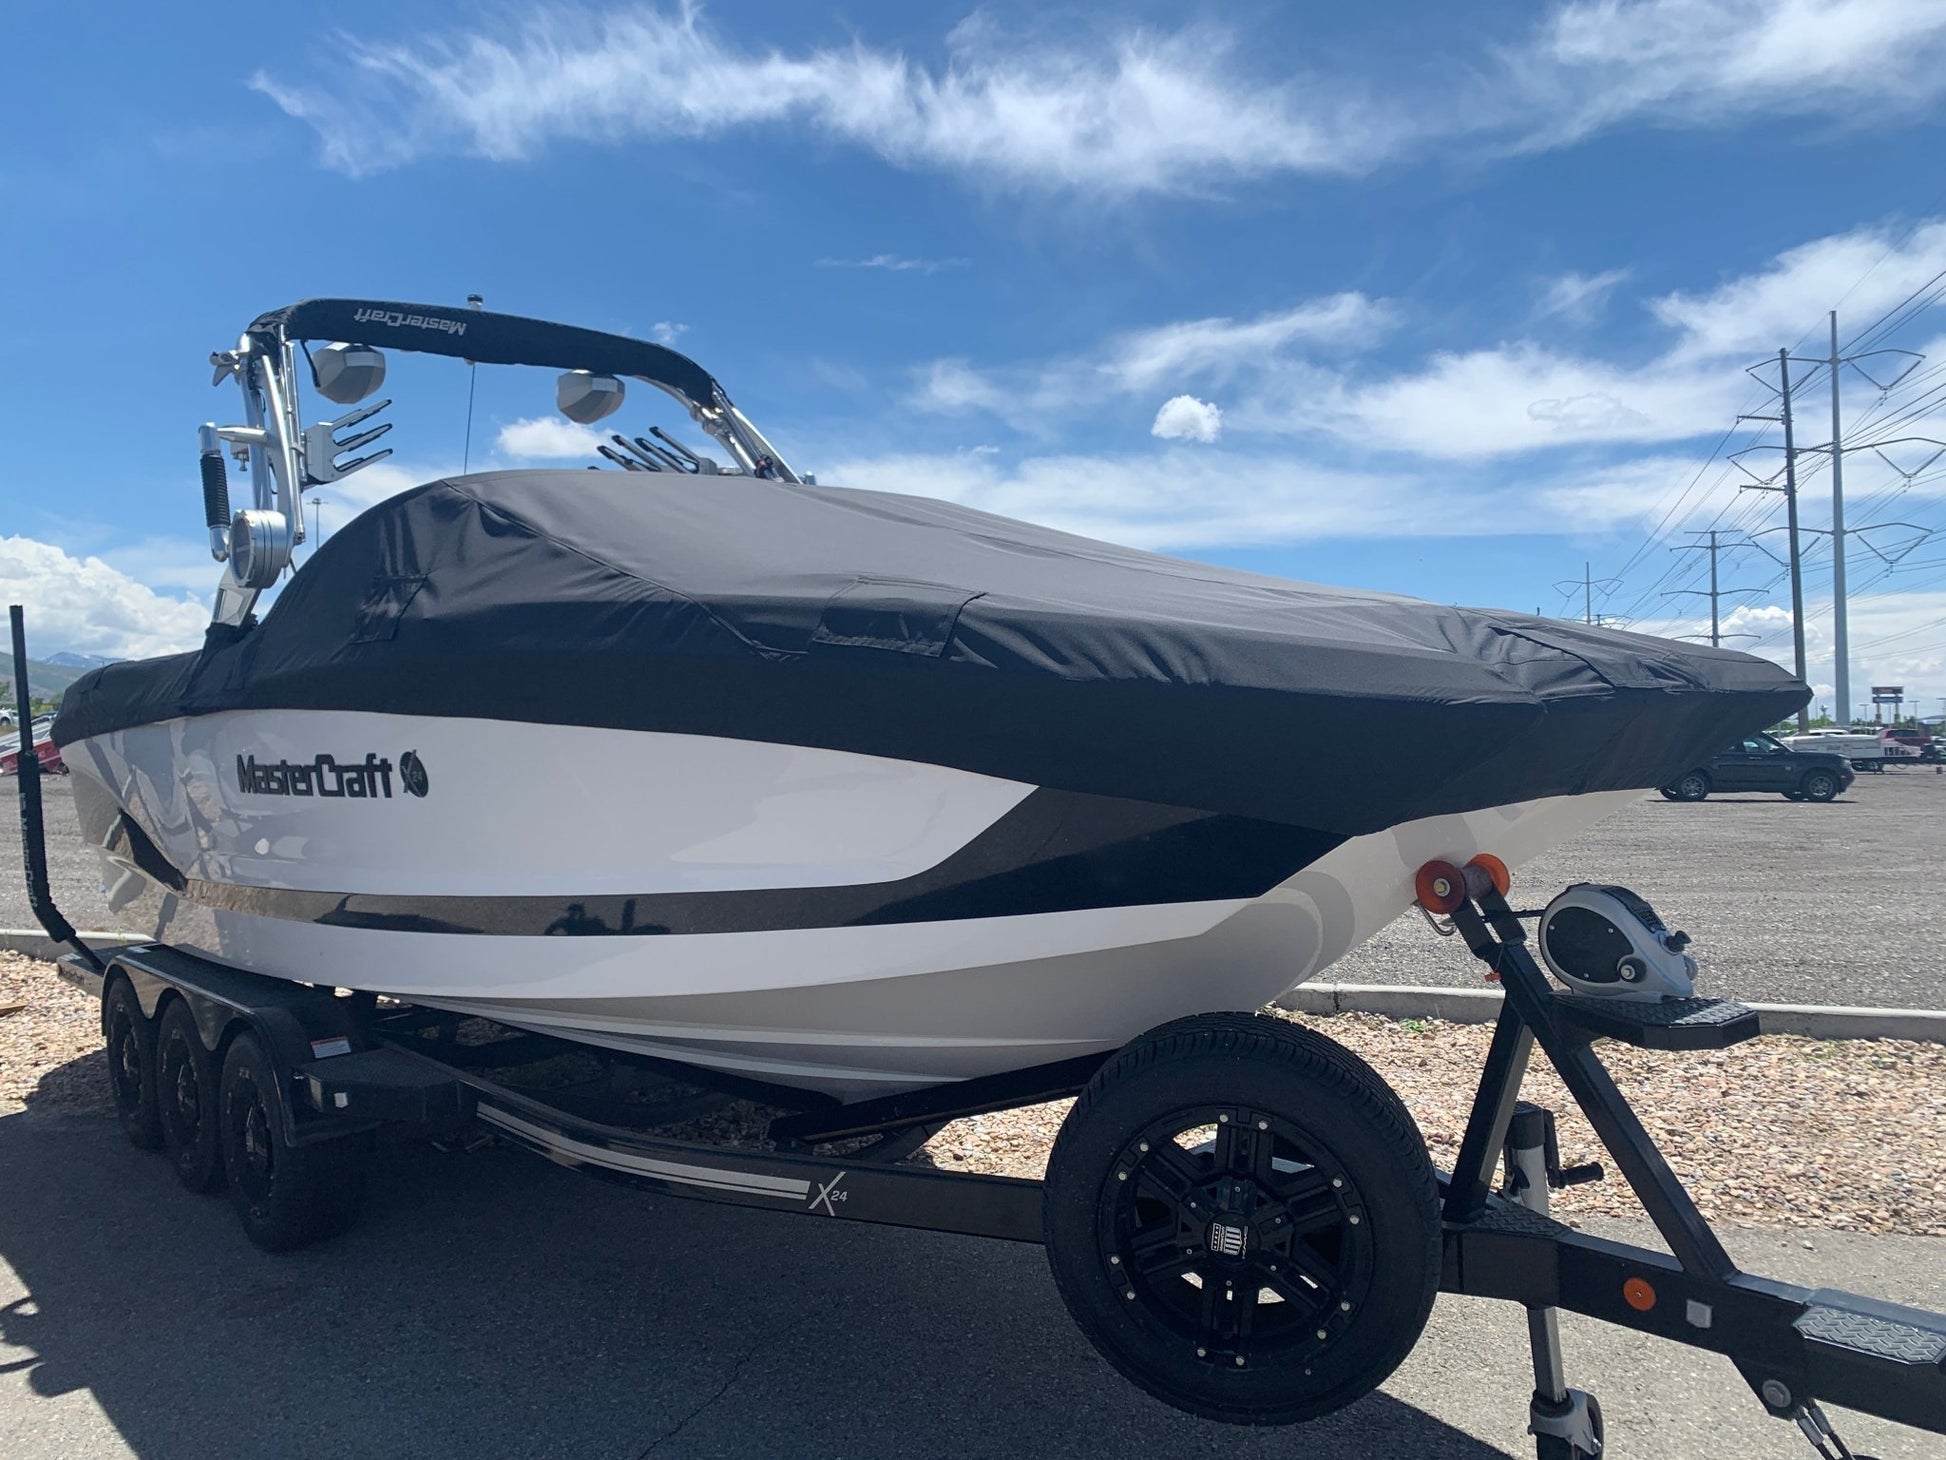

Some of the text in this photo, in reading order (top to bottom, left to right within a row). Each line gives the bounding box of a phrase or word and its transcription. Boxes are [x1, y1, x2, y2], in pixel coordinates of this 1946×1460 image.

[353, 308, 467, 336] MasterCraft
[236, 752, 393, 799] MasterCraft
[808, 1171, 848, 1217] X24
